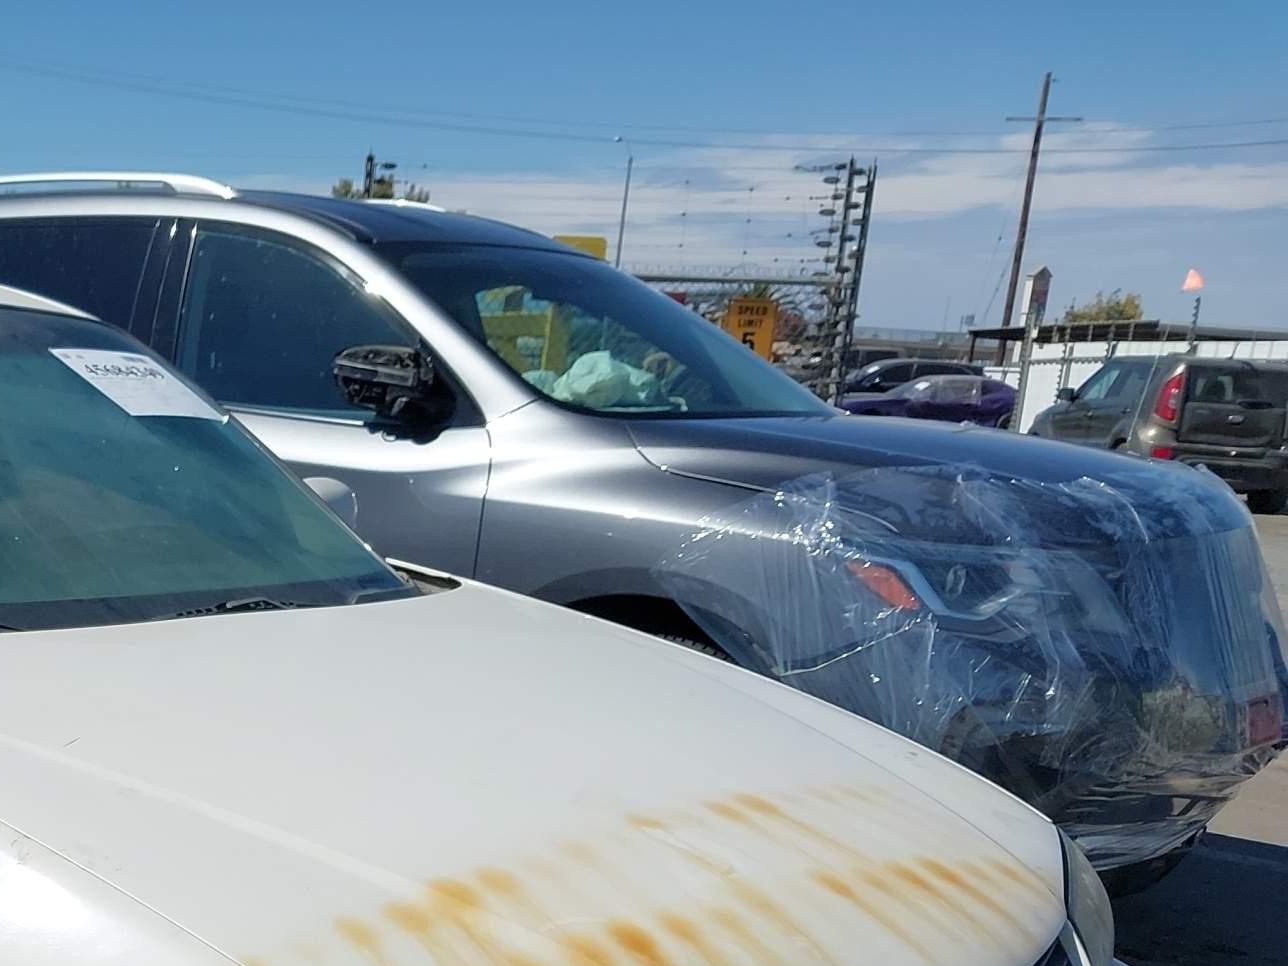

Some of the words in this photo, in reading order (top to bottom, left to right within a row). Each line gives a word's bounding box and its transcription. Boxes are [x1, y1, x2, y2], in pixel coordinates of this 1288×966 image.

[738, 305, 768, 315] SPEED
[738, 319, 764, 328] LIMIT
[742, 332, 755, 350] 5
